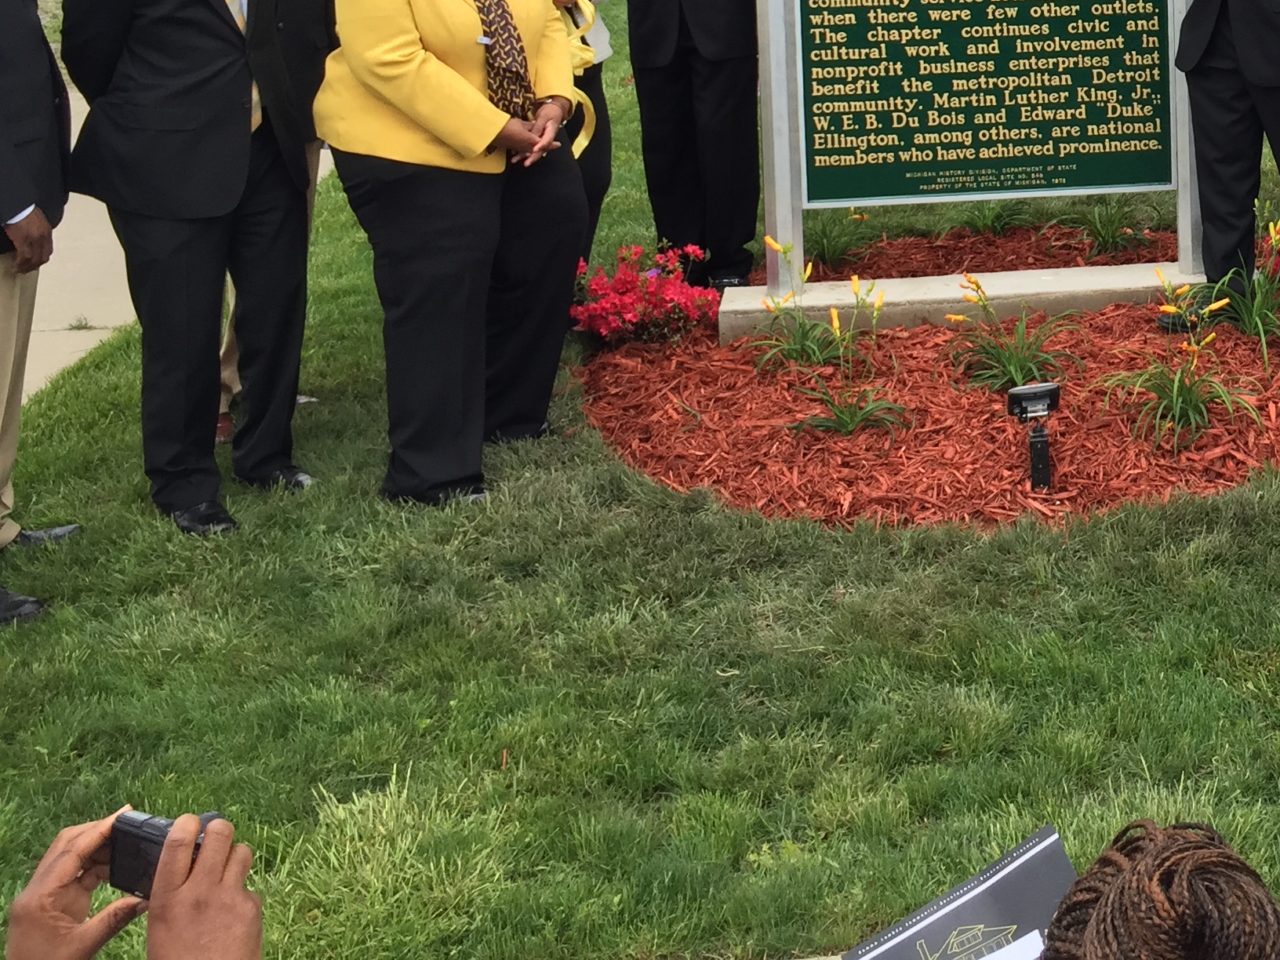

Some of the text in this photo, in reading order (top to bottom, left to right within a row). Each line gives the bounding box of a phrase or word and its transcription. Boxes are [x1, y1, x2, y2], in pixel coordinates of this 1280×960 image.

[809, 0, 1158, 25] when there were few other outlets.
[810, 16, 1159, 44] The chapter continues civic and
[811, 34, 1159, 61] cultural work and involvement in
[812, 51, 1159, 81] nonprofit business enterprises that
[812, 67, 1160, 96] benefit the metropolitan Detroit
[813, 97, 922, 113] community.
[933, 93, 996, 108] Martin
[1004, 90, 1068, 105] Luther
[813, 116, 834, 130] W.
[842, 114, 858, 130] E.
[865, 114, 882, 129] B.
[892, 112, 919, 127] Du
[928, 111, 965, 126] Bois
[974, 108, 1006, 124] and
[1021, 104, 1086, 121] Edward
[914, 131, 972, 146] among
[1052, 126, 1080, 137] are
[1087, 118, 1161, 135] national
[814, 139, 1161, 166] members who have achieved prominence.
